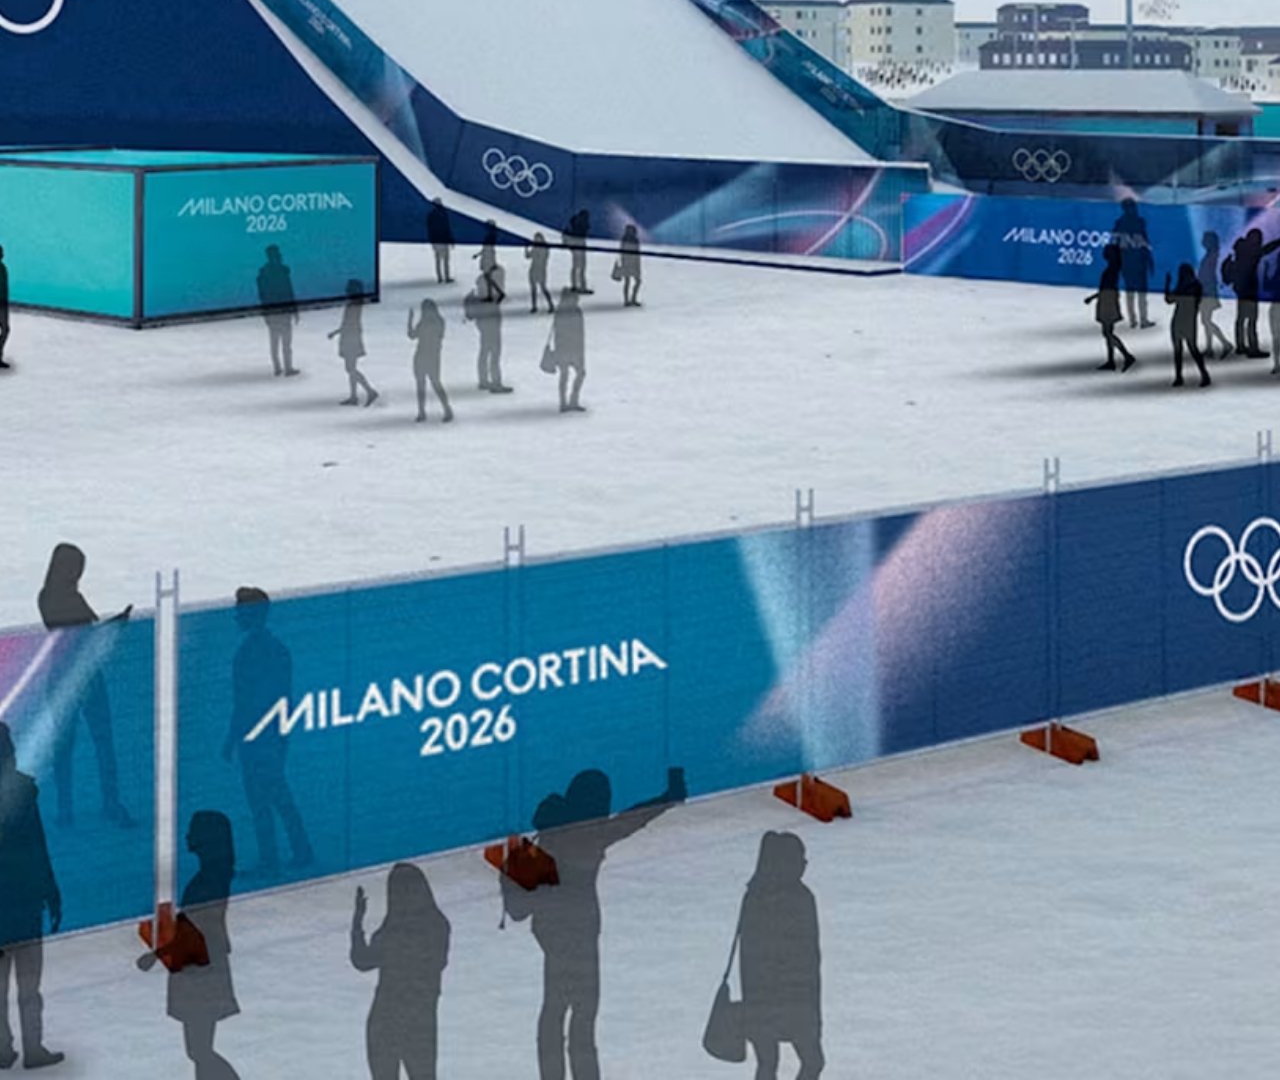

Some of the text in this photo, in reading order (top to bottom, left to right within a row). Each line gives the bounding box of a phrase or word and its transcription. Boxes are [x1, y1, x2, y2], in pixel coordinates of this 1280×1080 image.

[177, 192, 353, 217] MILANO CORTINA
[246, 214, 287, 233] 2026
[1002, 227, 1075, 245] MILANO
[1057, 247, 1093, 265] 2026
[243, 638, 668, 742] MILANO CORTINA
[419, 704, 517, 756] 2026
